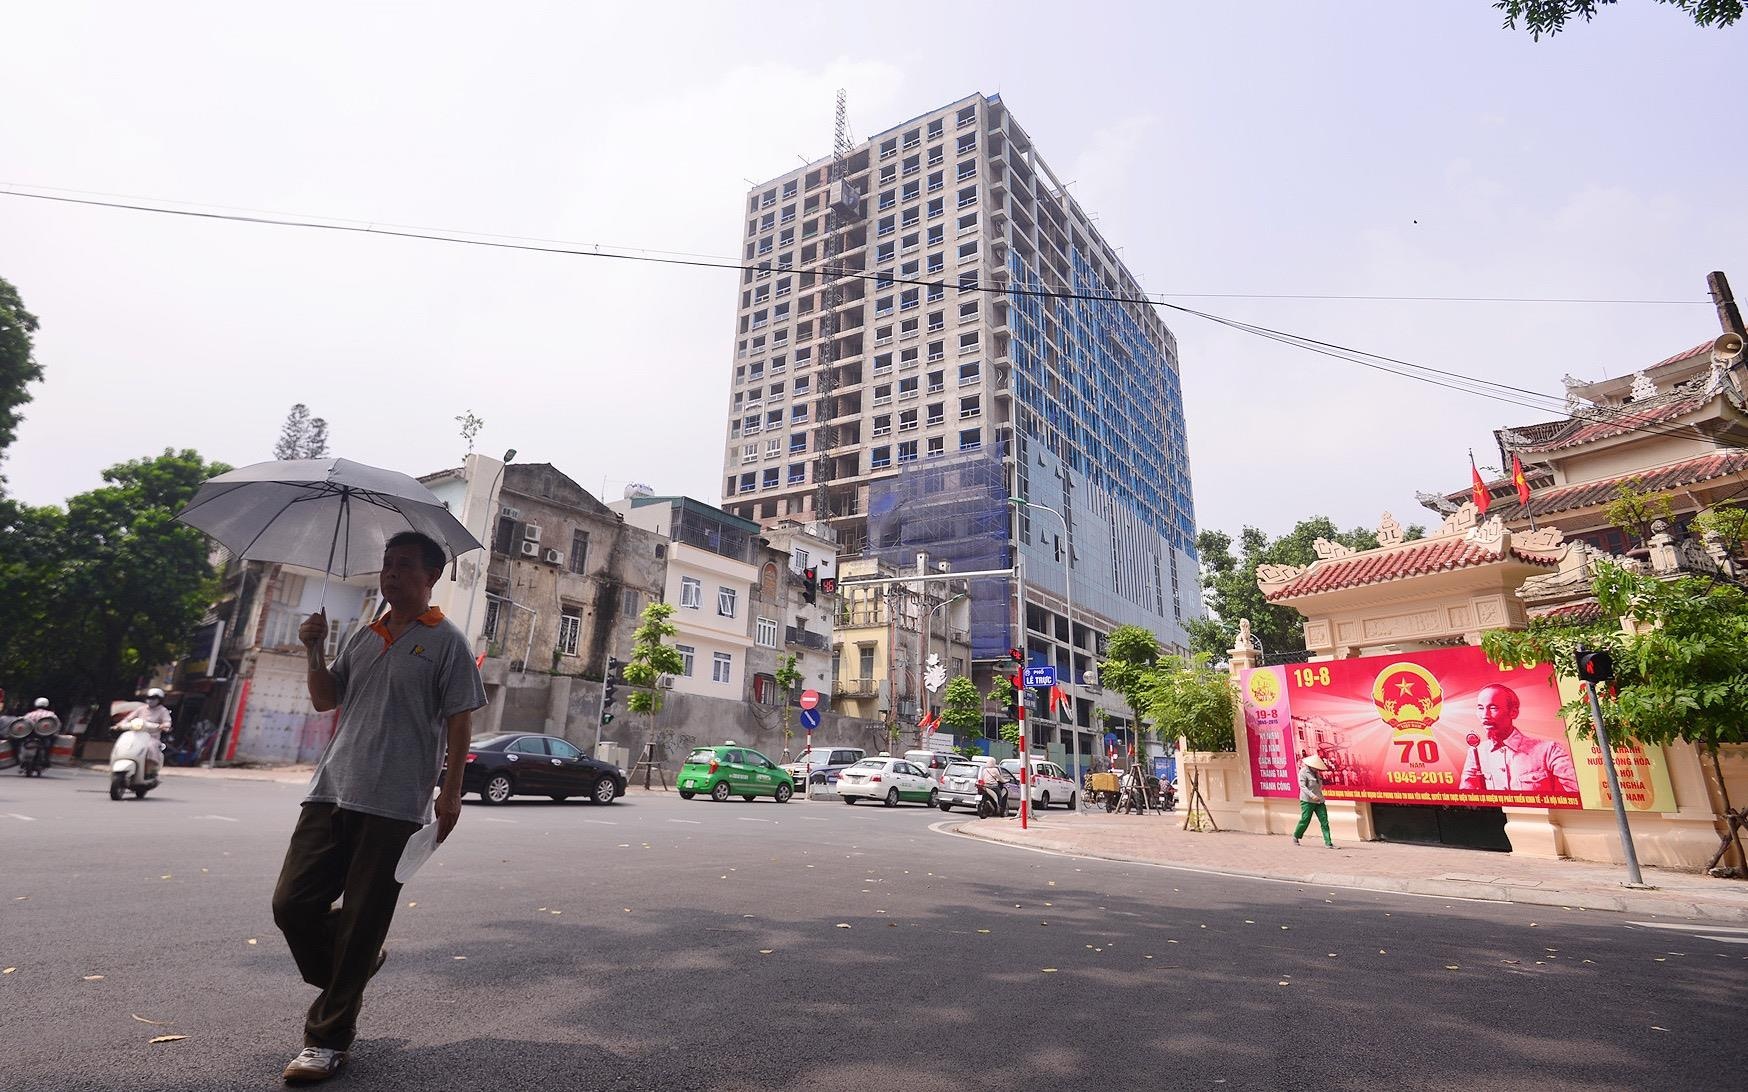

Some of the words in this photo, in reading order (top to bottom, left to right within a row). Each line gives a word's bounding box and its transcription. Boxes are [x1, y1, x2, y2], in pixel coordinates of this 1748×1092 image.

[1026, 676, 1034, 684] LÊ
[1035, 676, 1052, 685] TRỰC
[1293, 666, 1331, 688] 19-8
[1255, 709, 1278, 719] 19-8
[1393, 740, 1440, 764] 70
[1387, 771, 1454, 784] 1945-2015
[1625, 793, 1646, 802] NAM
